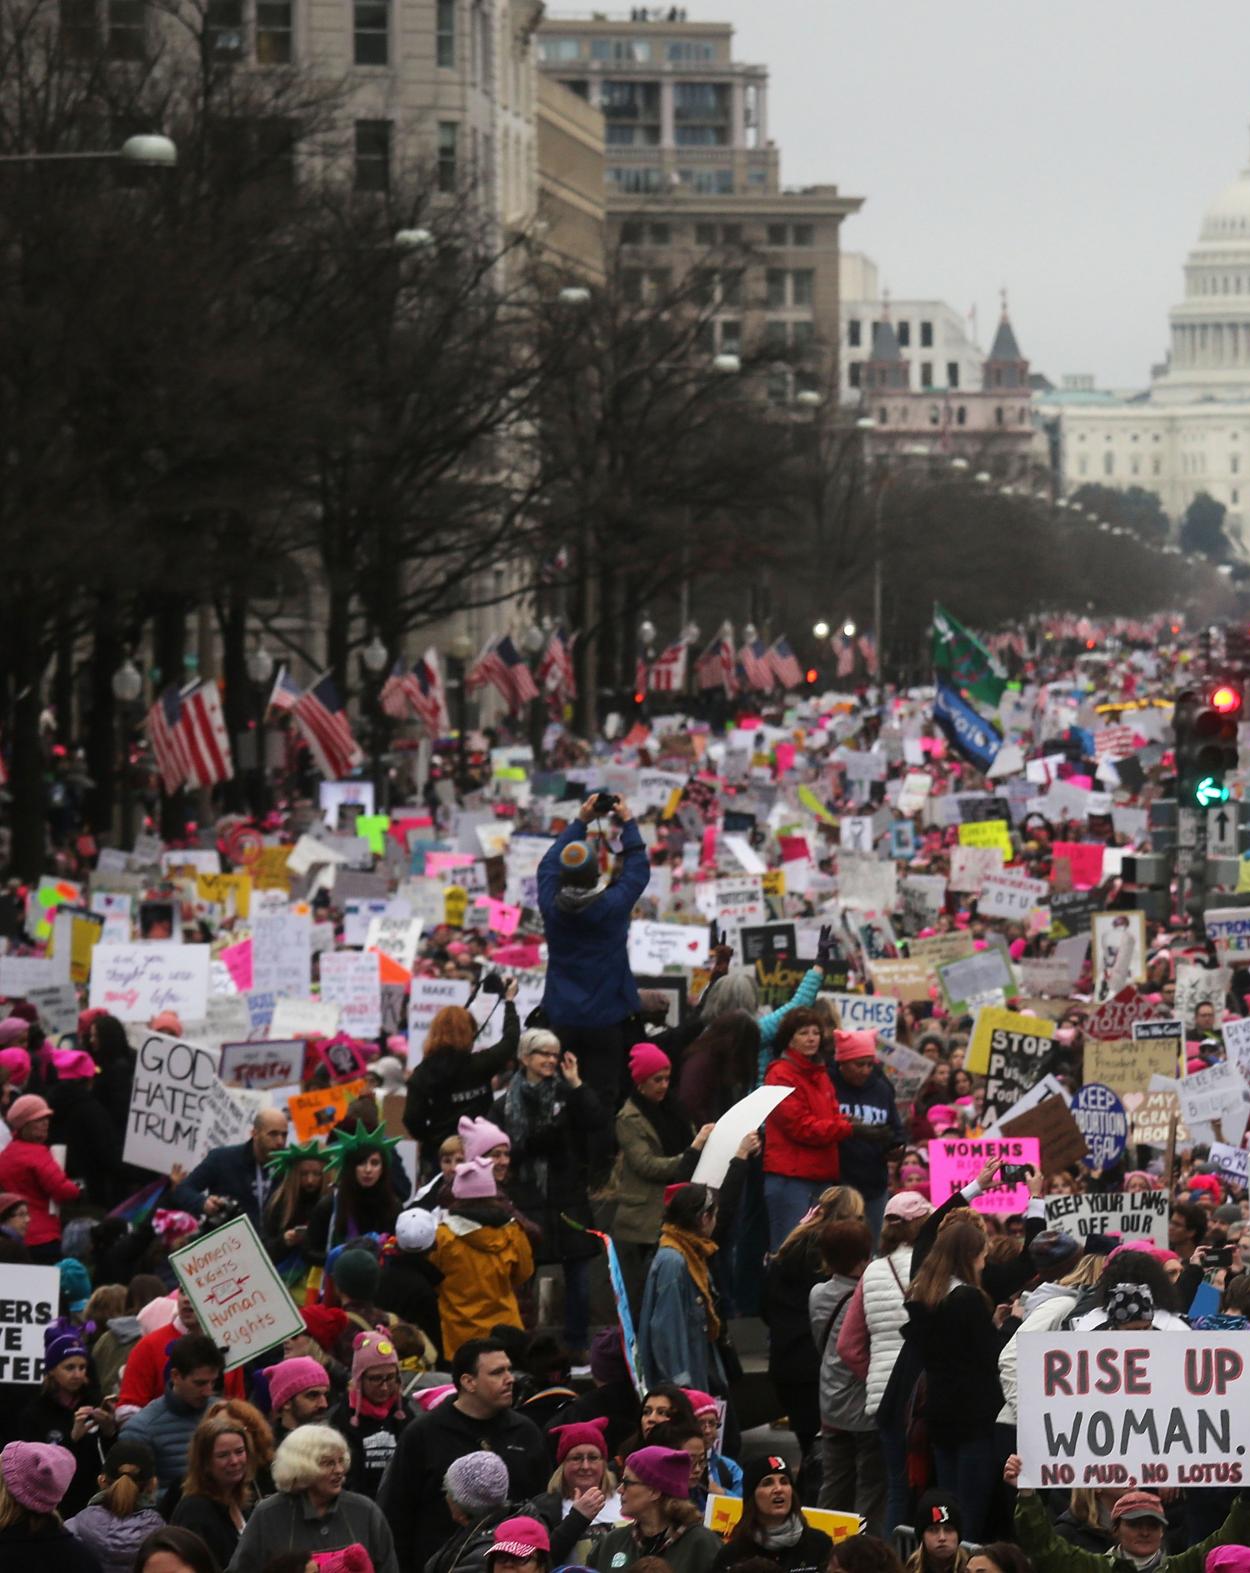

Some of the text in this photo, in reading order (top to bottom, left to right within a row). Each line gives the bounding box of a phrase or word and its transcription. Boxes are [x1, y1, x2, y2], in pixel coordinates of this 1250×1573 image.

[993, 1030, 1051, 1057] STOP
[141, 1037, 216, 1090] GOD
[1078, 1087, 1115, 1110] KEEP
[1147, 1093, 1175, 1108] MY
[944, 1143, 1023, 1158] WOMENS
[1045, 1195, 1083, 1221] KEEP
[1086, 1191, 1124, 1214] YOUR
[1078, 1216, 1109, 1237] OFF
[1121, 1214, 1153, 1234] OUR
[183, 1236, 242, 1277] Women's
[195, 1259, 239, 1289] RIGHTS
[208, 1290, 267, 1329] Human
[221, 1312, 276, 1346] Rights
[1044, 1348, 1244, 1396] RISE UP
[1044, 1408, 1246, 1457] WOMAN.
[1041, 1463, 1243, 1487] NO MUD, NO LOTUS
